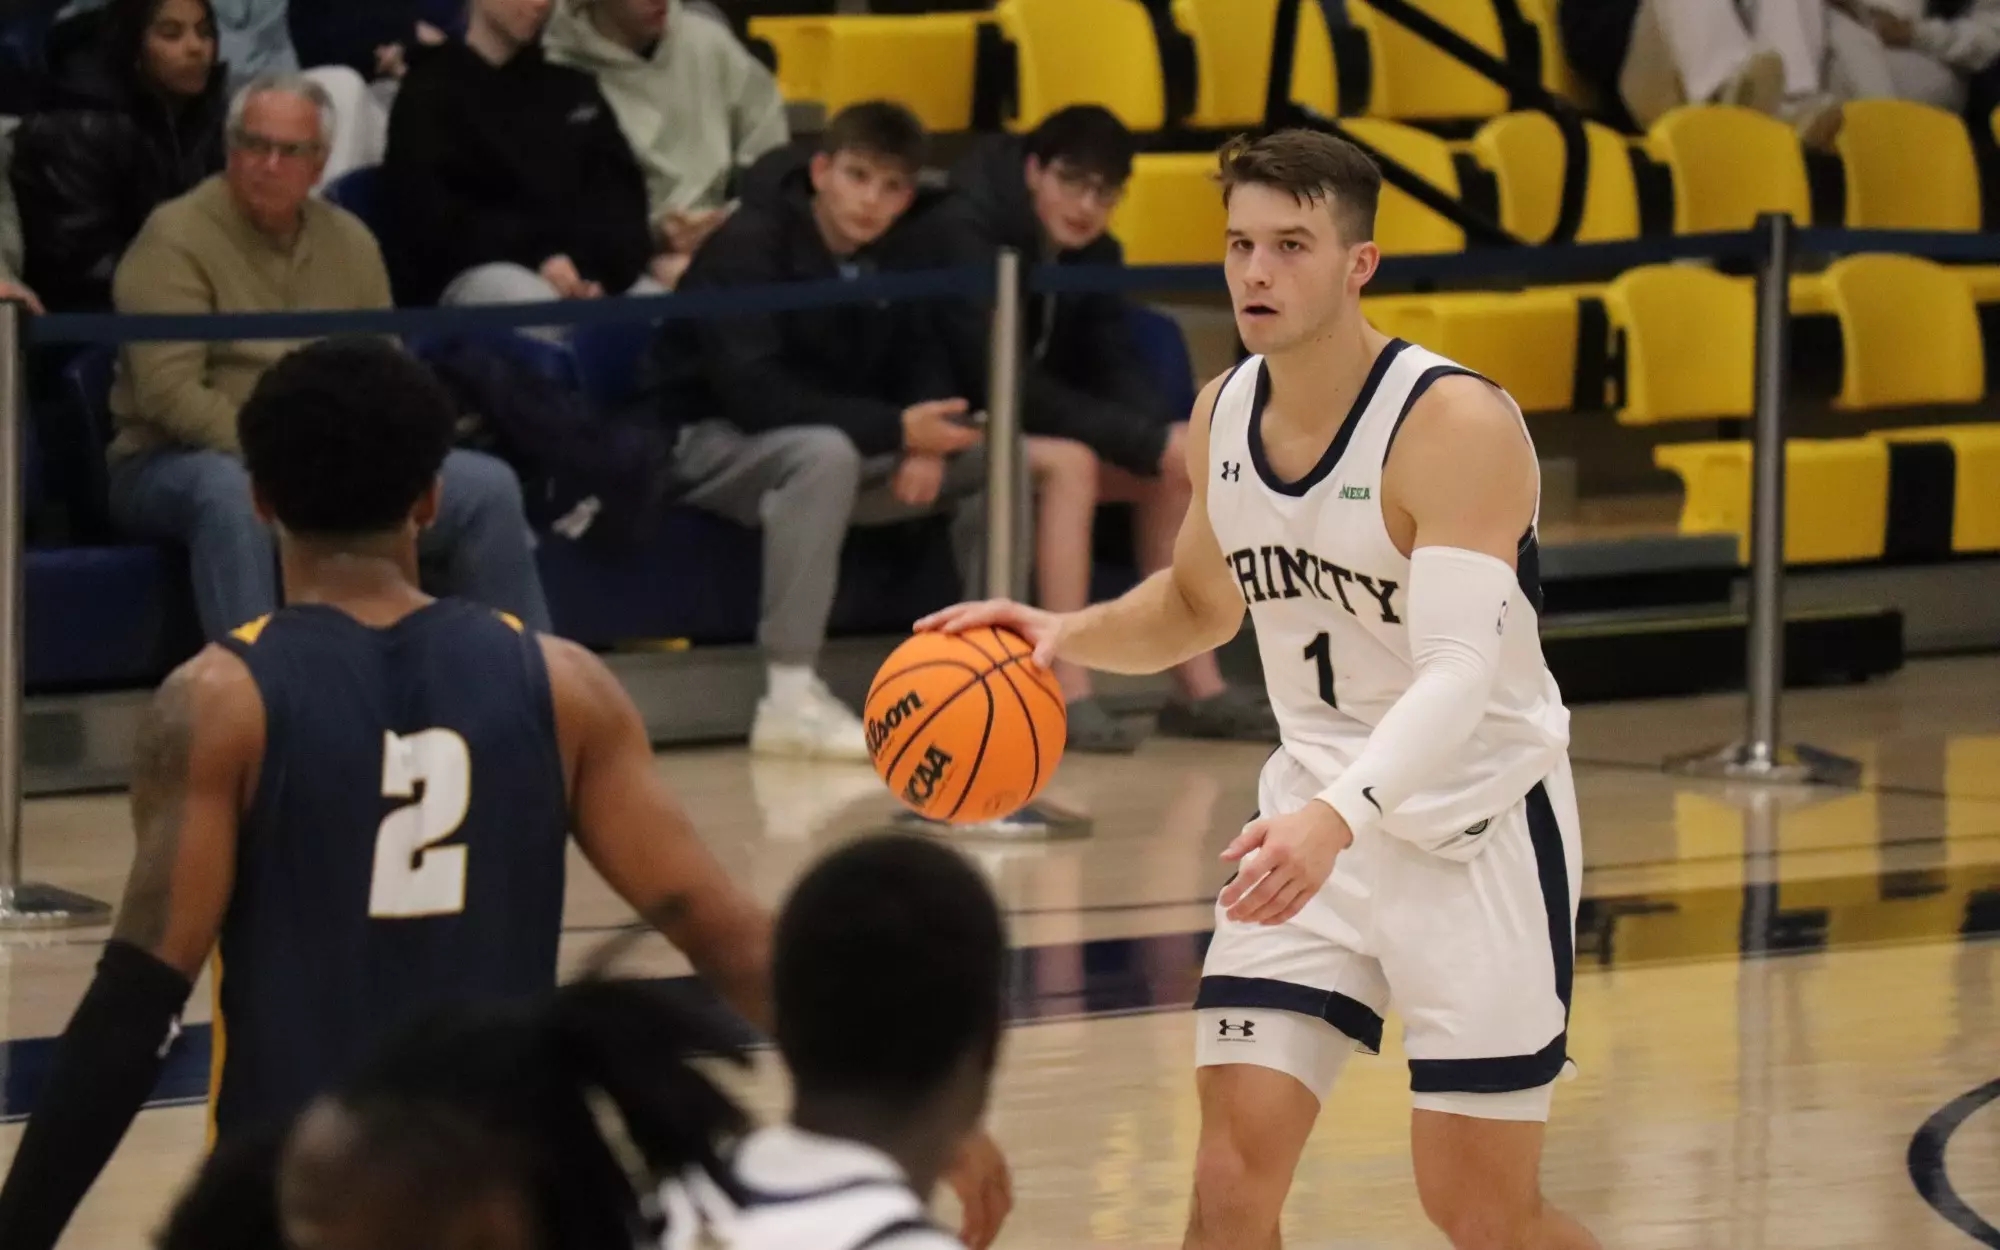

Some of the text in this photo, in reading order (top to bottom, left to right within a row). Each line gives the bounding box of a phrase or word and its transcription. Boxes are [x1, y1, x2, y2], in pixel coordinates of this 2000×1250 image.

[1226, 546, 1402, 624] RINITY
[1304, 632, 1338, 709] 1
[867, 690, 924, 757] lson
[904, 742, 953, 807] CAA
[368, 727, 472, 918] 2
